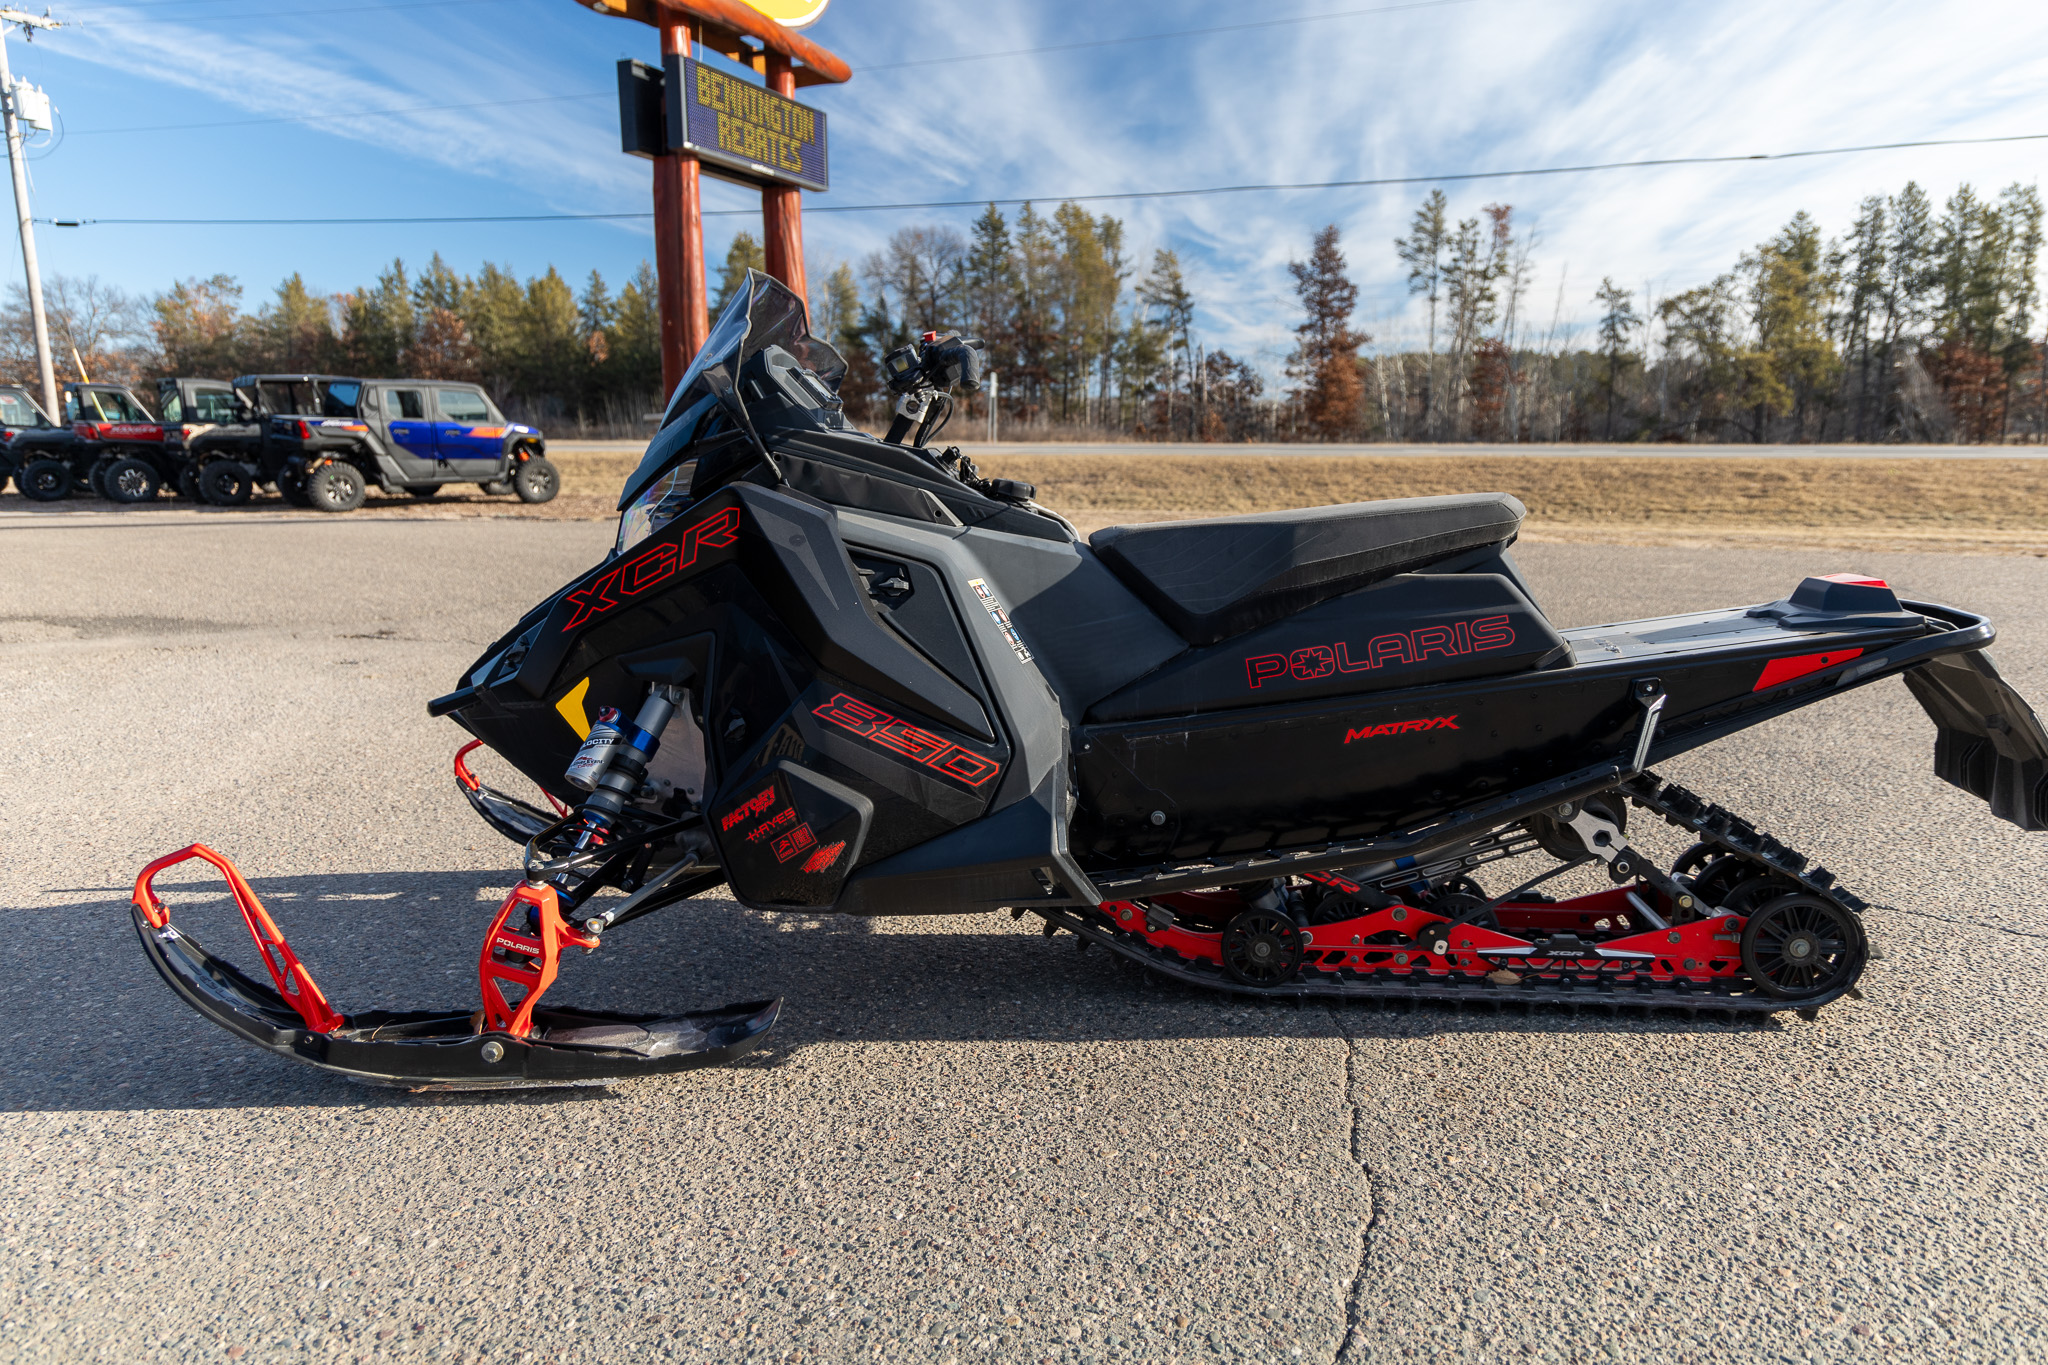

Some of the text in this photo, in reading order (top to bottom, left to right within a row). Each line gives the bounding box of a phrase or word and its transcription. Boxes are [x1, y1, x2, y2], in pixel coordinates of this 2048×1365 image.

[697, 66, 815, 145] BENNINGTON
[716, 110, 802, 173] REBATES
[561, 507, 740, 632] XCR
[1245, 614, 1515, 688] POLARIS
[583, 738, 614, 747] LOCITY
[811, 692, 1000, 787] 850
[1343, 714, 1460, 744] MATRYX
[721, 785, 775, 831] FACTORY
[745, 807, 796, 840] HAYES
[792, 827, 808, 839] ROAD
[1303, 871, 1360, 894] CR
[496, 937, 540, 955] POLARIS
